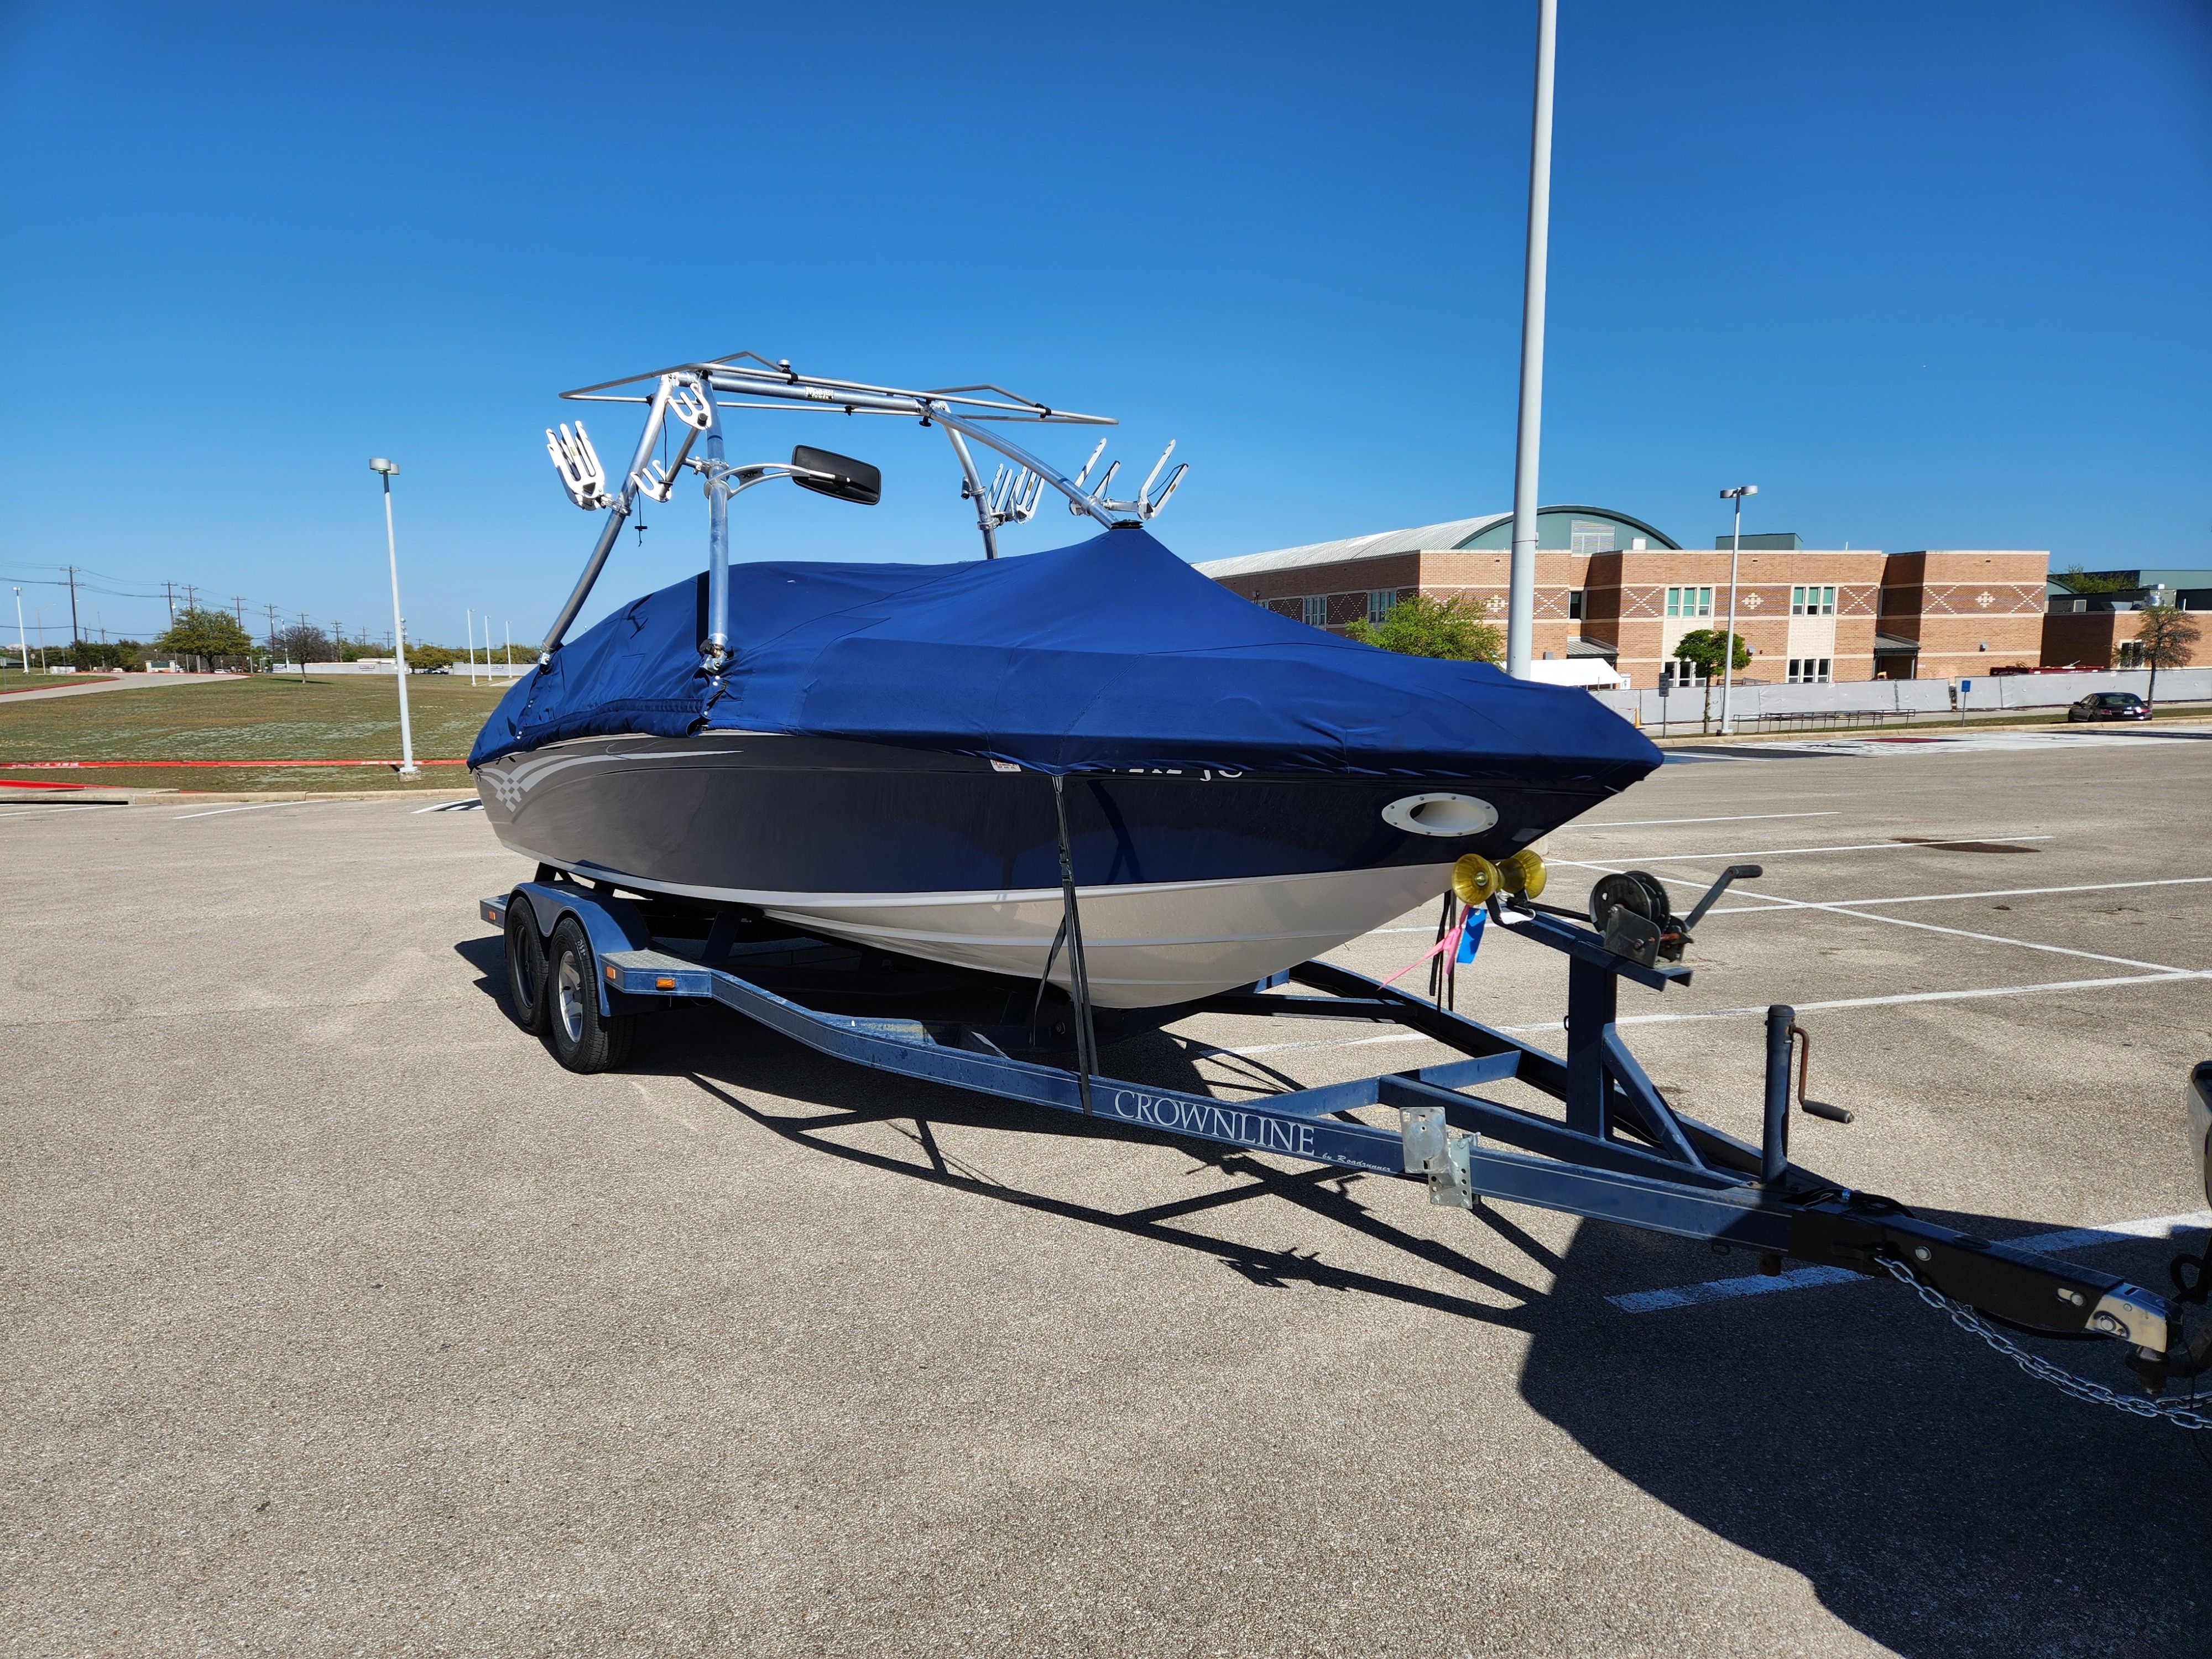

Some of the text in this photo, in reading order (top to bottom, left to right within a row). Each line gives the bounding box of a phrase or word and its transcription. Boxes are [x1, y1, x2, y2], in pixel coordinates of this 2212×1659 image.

[1115, 1091, 1315, 1156] CROWNLINE
[1322, 1152, 1391, 1171] by Roadrunner
